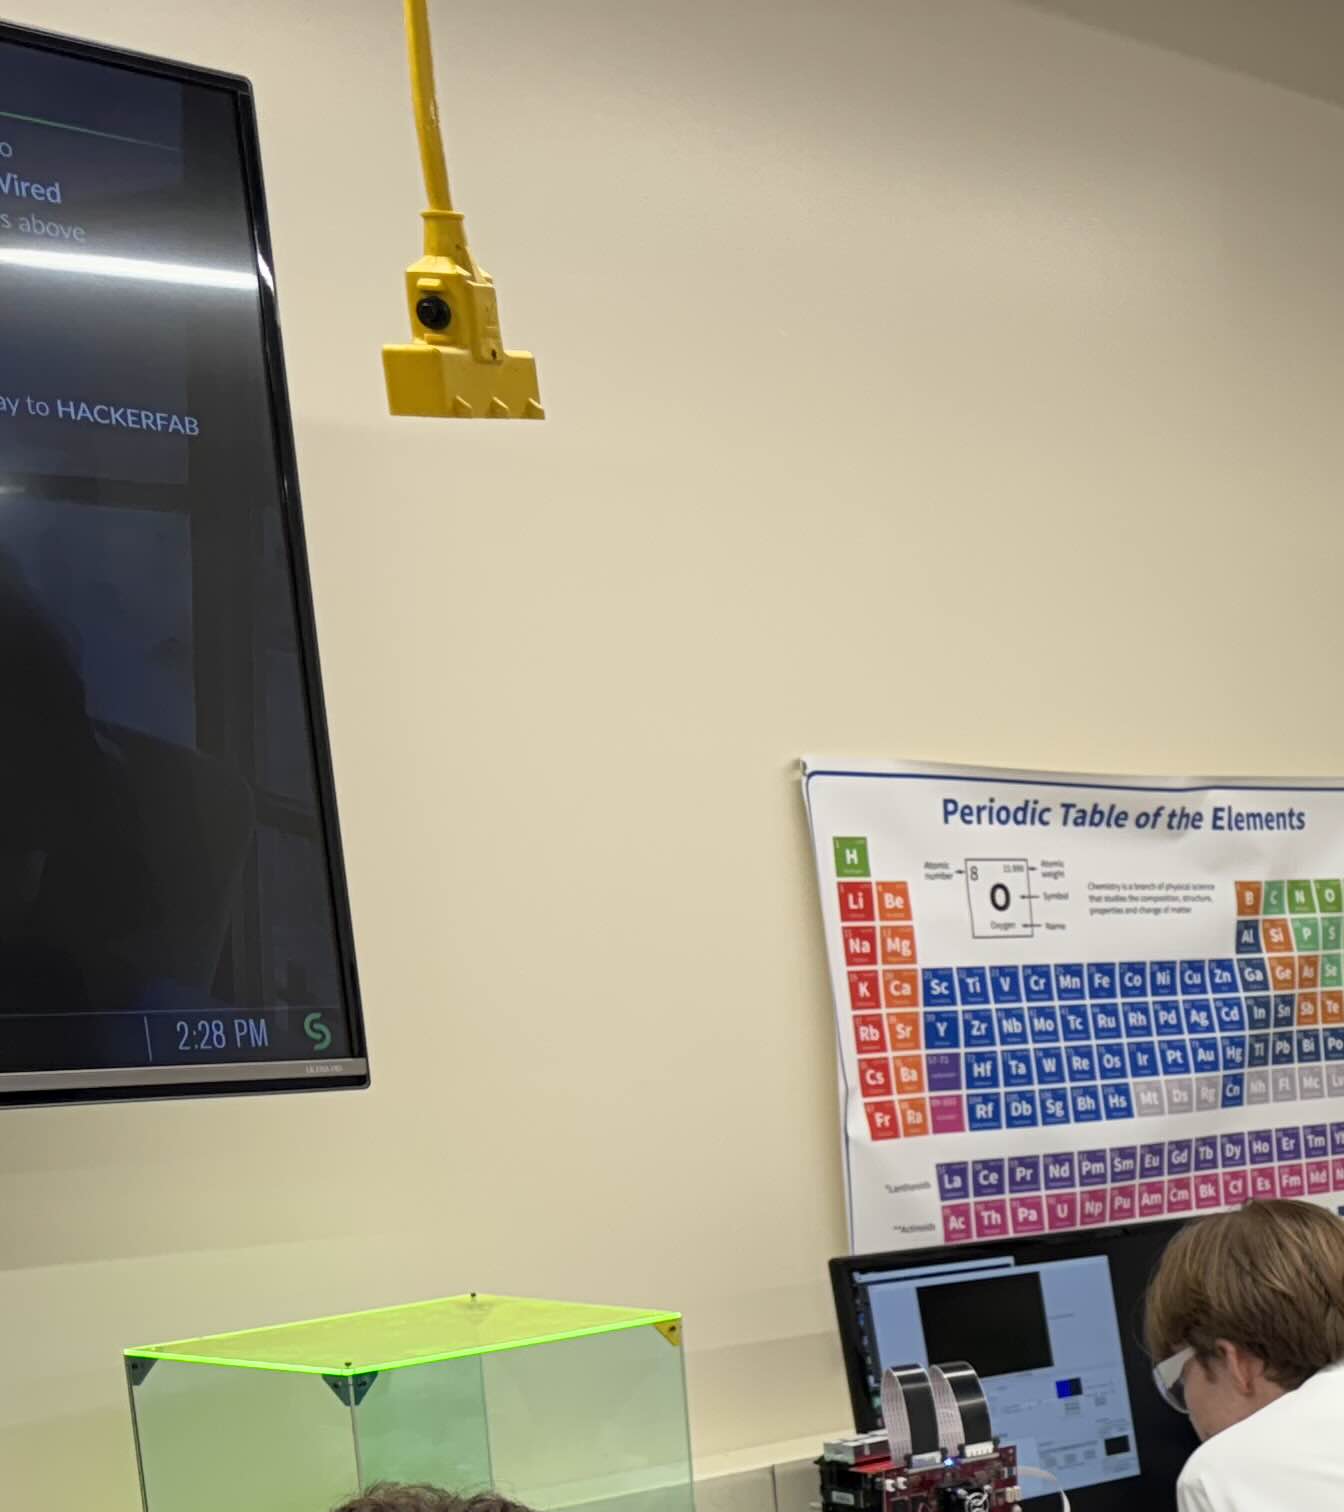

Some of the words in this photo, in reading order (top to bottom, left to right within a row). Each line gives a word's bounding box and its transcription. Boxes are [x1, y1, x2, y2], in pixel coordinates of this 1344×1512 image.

[19, 213, 86, 241] above
[26, 395, 50, 416] to
[56, 399, 200, 436] HACKERFAB
[942, 797, 1051, 826] Periodic
[1061, 802, 1128, 829] Table
[1135, 806, 1165, 829] of
[1167, 806, 1204, 831] the
[1212, 806, 1306, 831] Elements
[846, 848, 858, 864] H
[970, 866, 979, 881] 8
[847, 892, 864, 909] Li
[883, 892, 904, 909] Be
[848, 937, 871, 954] Na
[887, 937, 912, 957] Mg
[858, 982, 871, 998] K
[890, 981, 912, 996] Ca
[930, 980, 949, 995] Sc
[966, 977, 981, 993] Ti
[1000, 977, 1011, 992] V
[1030, 976, 1046, 991] Cr
[1059, 976, 1080, 989] Mn
[1094, 974, 1110, 988] Fe
[1124, 973, 1142, 987] Co
[1156, 970, 1171, 985] Ni
[1184, 970, 1201, 984] Cu
[1214, 969, 1231, 983] Zn
[1244, 967, 1264, 981] Ga
[176, 1020, 227, 1050] 2:28
[234, 1018, 269, 1048] PM
[859, 1025, 880, 1041] Rb
[895, 1023, 912, 1039] Sr
[936, 1022, 947, 1037] Y
[971, 1020, 987, 1036] Zr
[1002, 1017, 1022, 1033] Nb
[1033, 1017, 1054, 1032] Mo
[1068, 1016, 1083, 1030] Tc
[1097, 1014, 1116, 1028] Ru
[1128, 1011, 1147, 1026] Rh
[1159, 1010, 1177, 1025] Pd
[1190, 1010, 1209, 1027] Ag
[1221, 1006, 1240, 1022] Cd
[865, 1070, 885, 1085] Cs
[973, 1061, 992, 1078] Hf
[1009, 1060, 1026, 1075] Ta
[1043, 1059, 1056, 1073] W
[1072, 1056, 1090, 1070] Re
[1103, 1055, 1121, 1069] Os
[1137, 1052, 1149, 1066] Ir
[1166, 1050, 1183, 1064] Pt
[1198, 1048, 1215, 1062] Au
[1226, 1047, 1243, 1063] Hg
[1275, 1040, 1290, 1055] Pb
[1302, 1039, 1315, 1053] Bi
[1327, 1037, 1343, 1050] Po
[874, 1113, 890, 1128] Fr
[976, 1103, 994, 1119] Rf
[1010, 1101, 1032, 1117] Db
[1046, 1100, 1063, 1117] Sg
[1076, 1097, 1095, 1111] Bh
[1108, 1094, 1126, 1108] Hs
[944, 1174, 961, 1189] La
[978, 1170, 998, 1185] Ce
[1015, 1167, 1033, 1182] Pr
[1049, 1163, 1069, 1178] Nd
[1082, 1160, 1104, 1175] Pm
[1113, 1157, 1134, 1172] Sm
[1144, 1153, 1159, 1168] Eu
[1171, 1149, 1188, 1164] Gd
[1199, 1145, 1214, 1160] Tb
[1225, 1143, 1241, 1160] Dy
[1253, 1139, 1270, 1154] Ho
[1281, 1136, 1296, 1151] Er
[1307, 1133, 1325, 1148] Tm
[949, 1215, 965, 1229] Ac
[981, 1210, 1000, 1226] Th
[1017, 1208, 1037, 1222] Pa
[1057, 1203, 1068, 1218] U
[1084, 1199, 1103, 1217] Np
[1114, 1195, 1131, 1210] Pu
[1141, 1191, 1162, 1206] Am
[1170, 1187, 1189, 1201] Cm
[1200, 1183, 1216, 1199] Bk
[1257, 1177, 1270, 1192] Es
[1281, 1171, 1301, 1187] Fm
